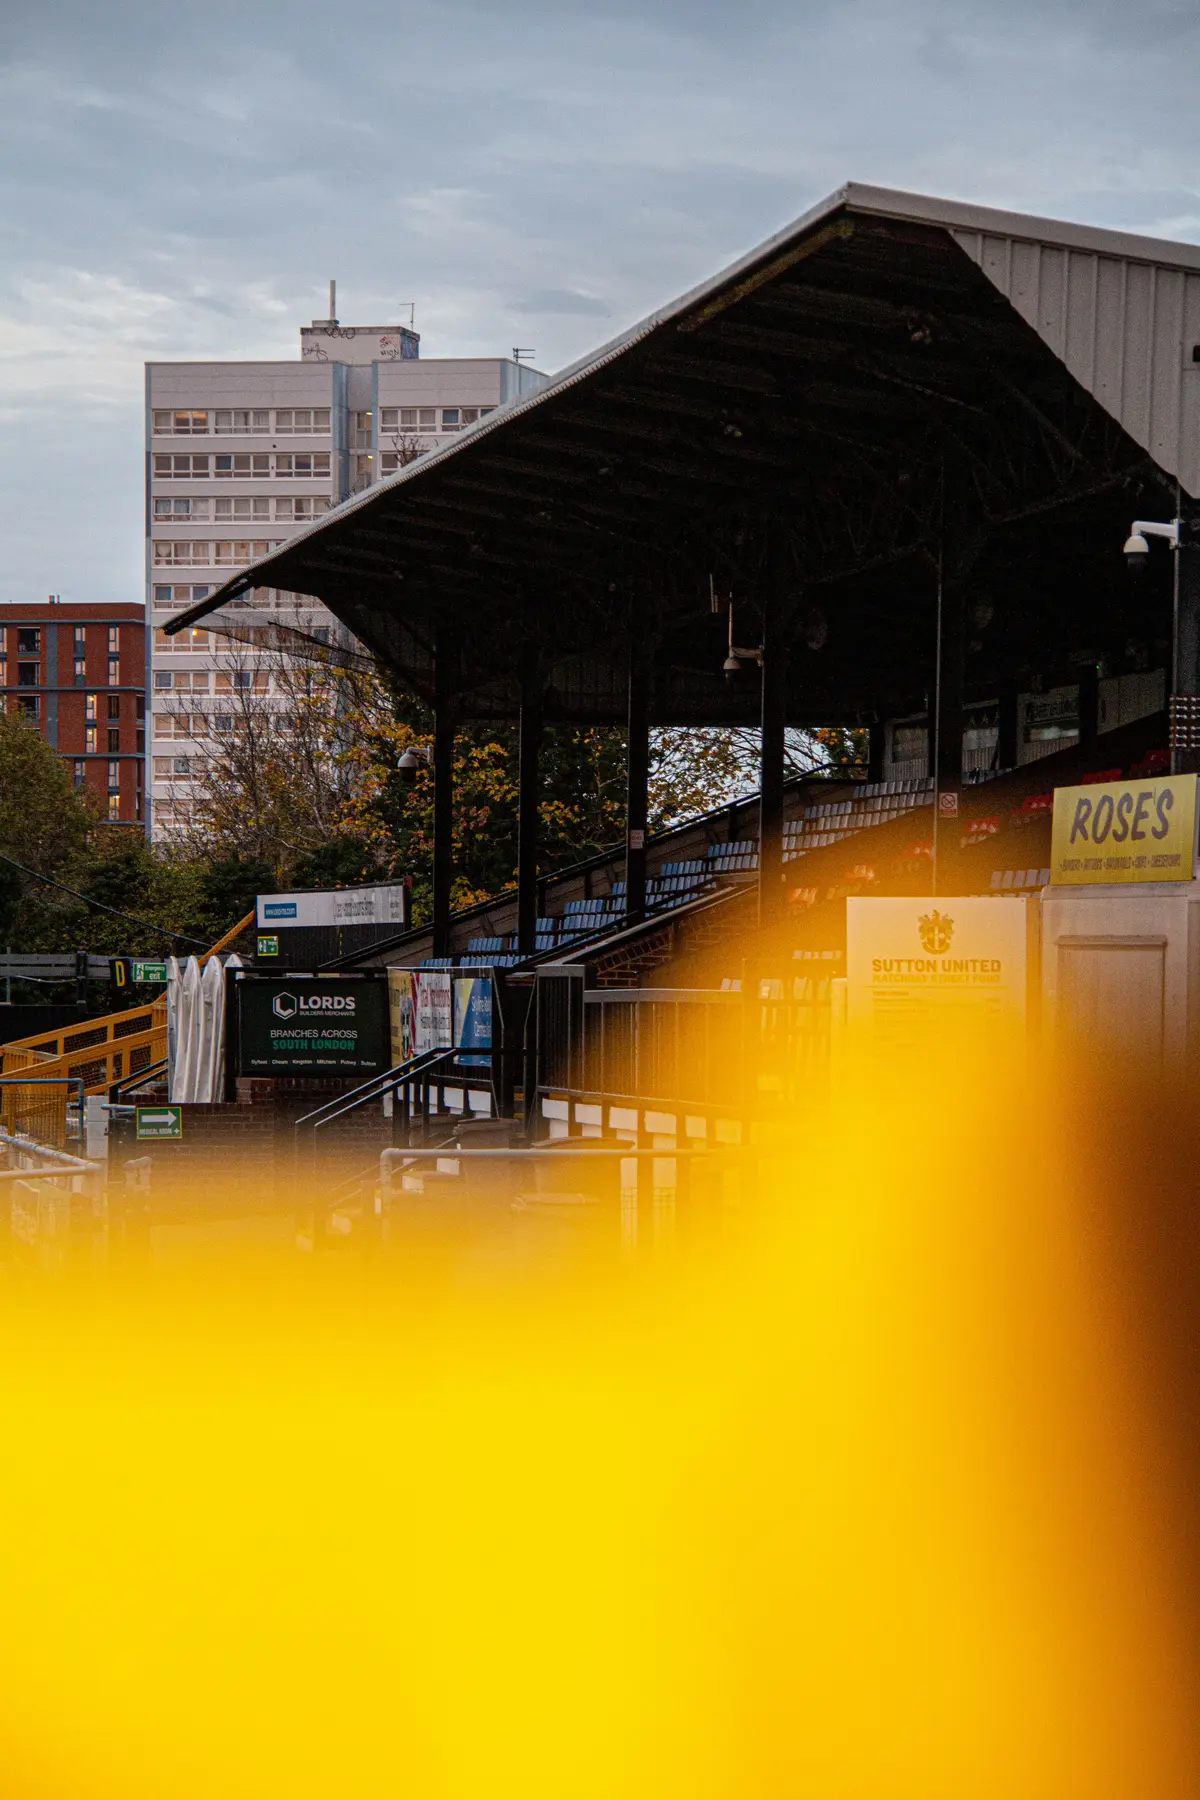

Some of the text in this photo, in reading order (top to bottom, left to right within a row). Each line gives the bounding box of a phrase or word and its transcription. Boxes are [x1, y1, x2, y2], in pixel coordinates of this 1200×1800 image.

[872, 959, 1002, 973] SUTTON UNITED
[115, 960, 126, 987] D
[149, 972, 161, 980] exit
[299, 996, 356, 1010] LORDS
[270, 1029, 358, 1039] BRANCHES ACROSS
[272, 1040, 355, 1051] SOUTH LONDON
